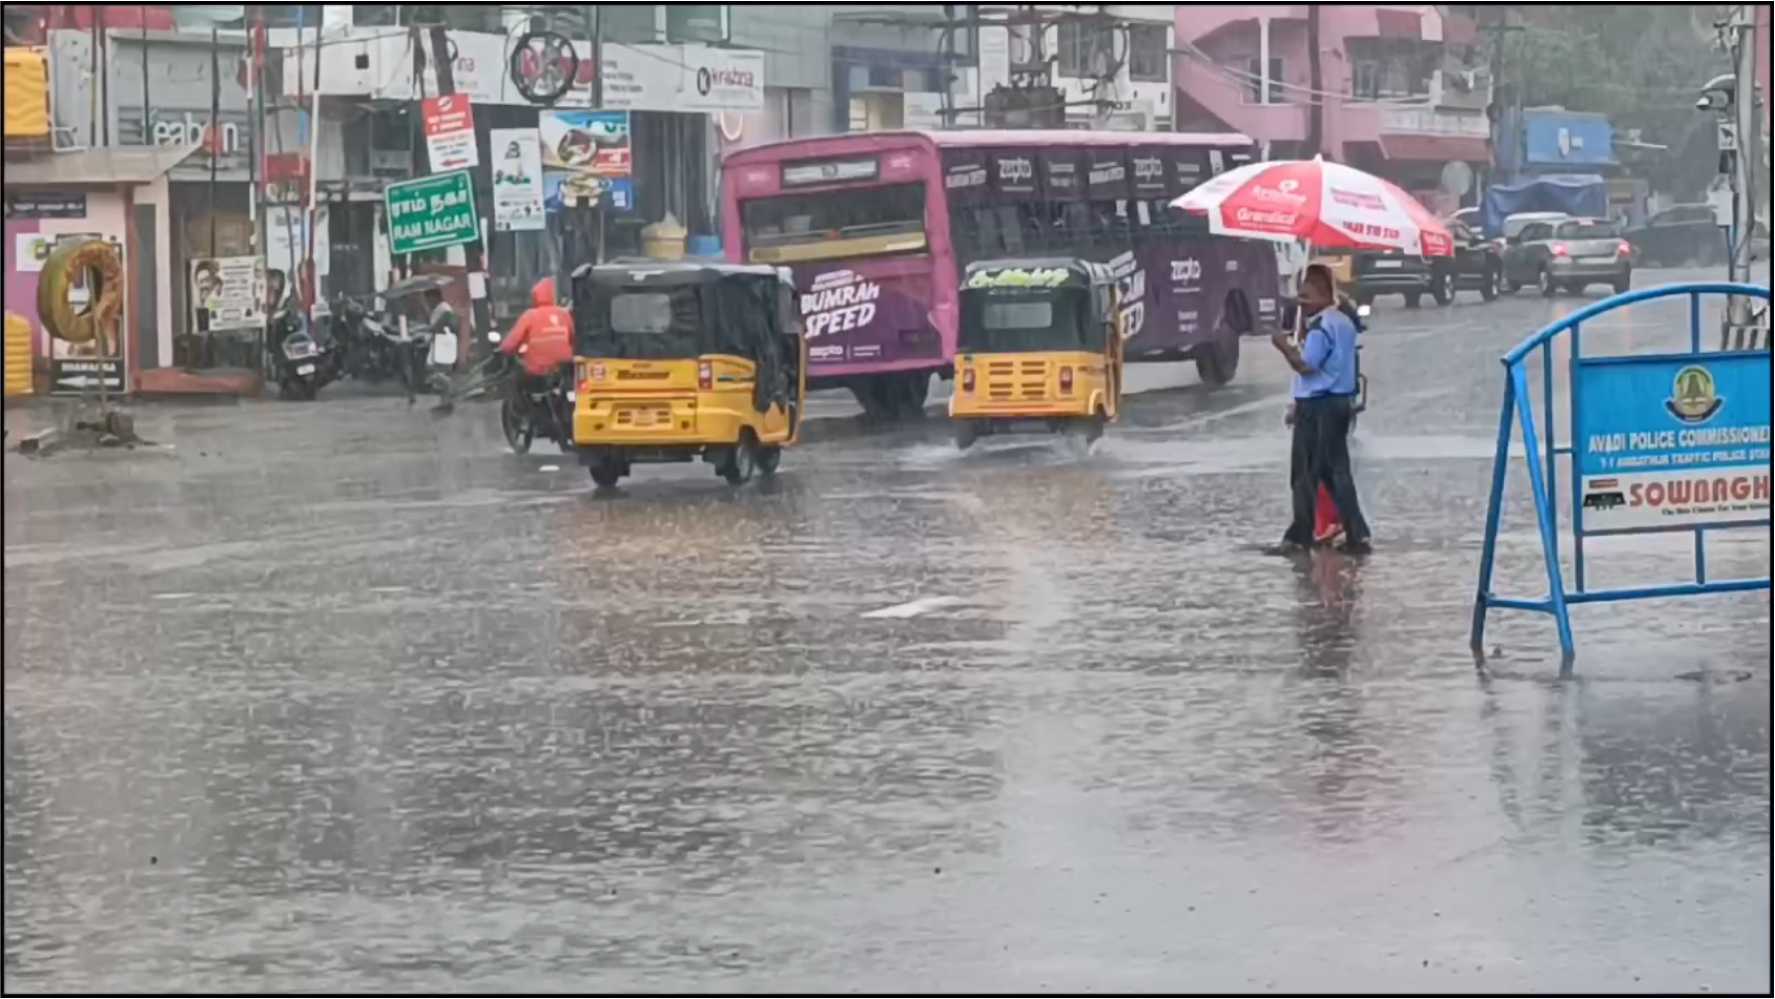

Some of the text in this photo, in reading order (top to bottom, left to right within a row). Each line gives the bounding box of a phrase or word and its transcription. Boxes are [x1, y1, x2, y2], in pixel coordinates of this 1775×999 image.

[142, 107, 238, 153] eabn
[394, 213, 472, 239] RAM NAGAR
[800, 282, 880, 314] BUMRAH
[804, 302, 876, 339] SPEED
[1588, 434, 1626, 454] AVADI
[1629, 430, 1676, 450] POLICE
